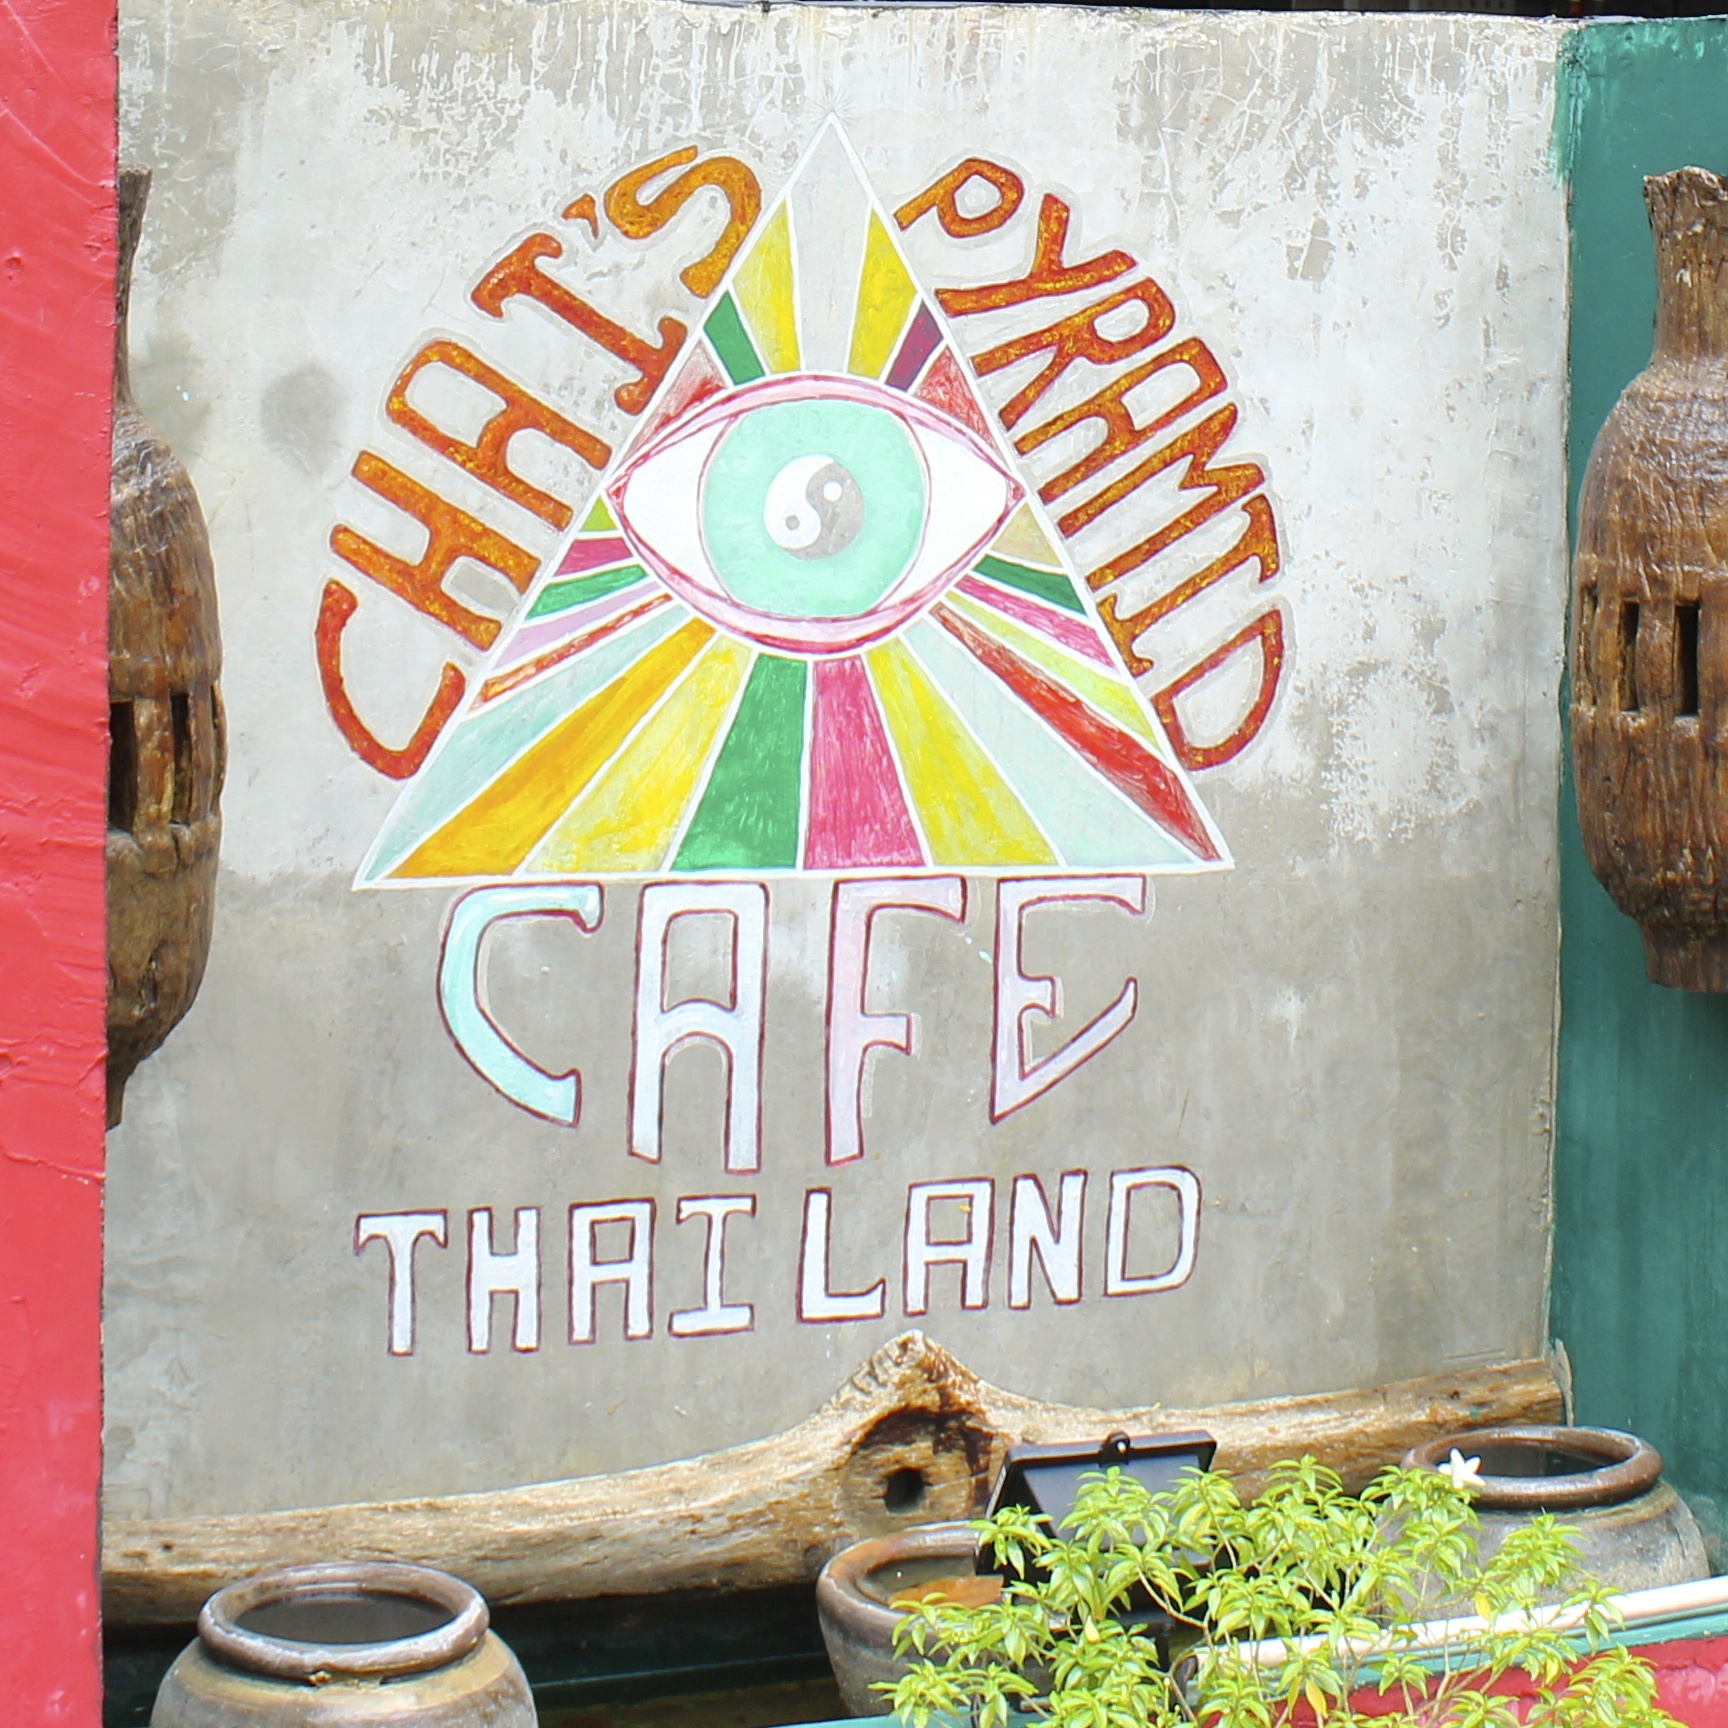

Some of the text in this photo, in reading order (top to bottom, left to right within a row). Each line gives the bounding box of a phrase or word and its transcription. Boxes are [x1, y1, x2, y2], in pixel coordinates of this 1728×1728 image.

[313, 144, 1284, 781] CHAI'S PYRAMID
[437, 878, 1149, 1172] CAFE
[355, 1167, 1202, 1355] THAILAND
